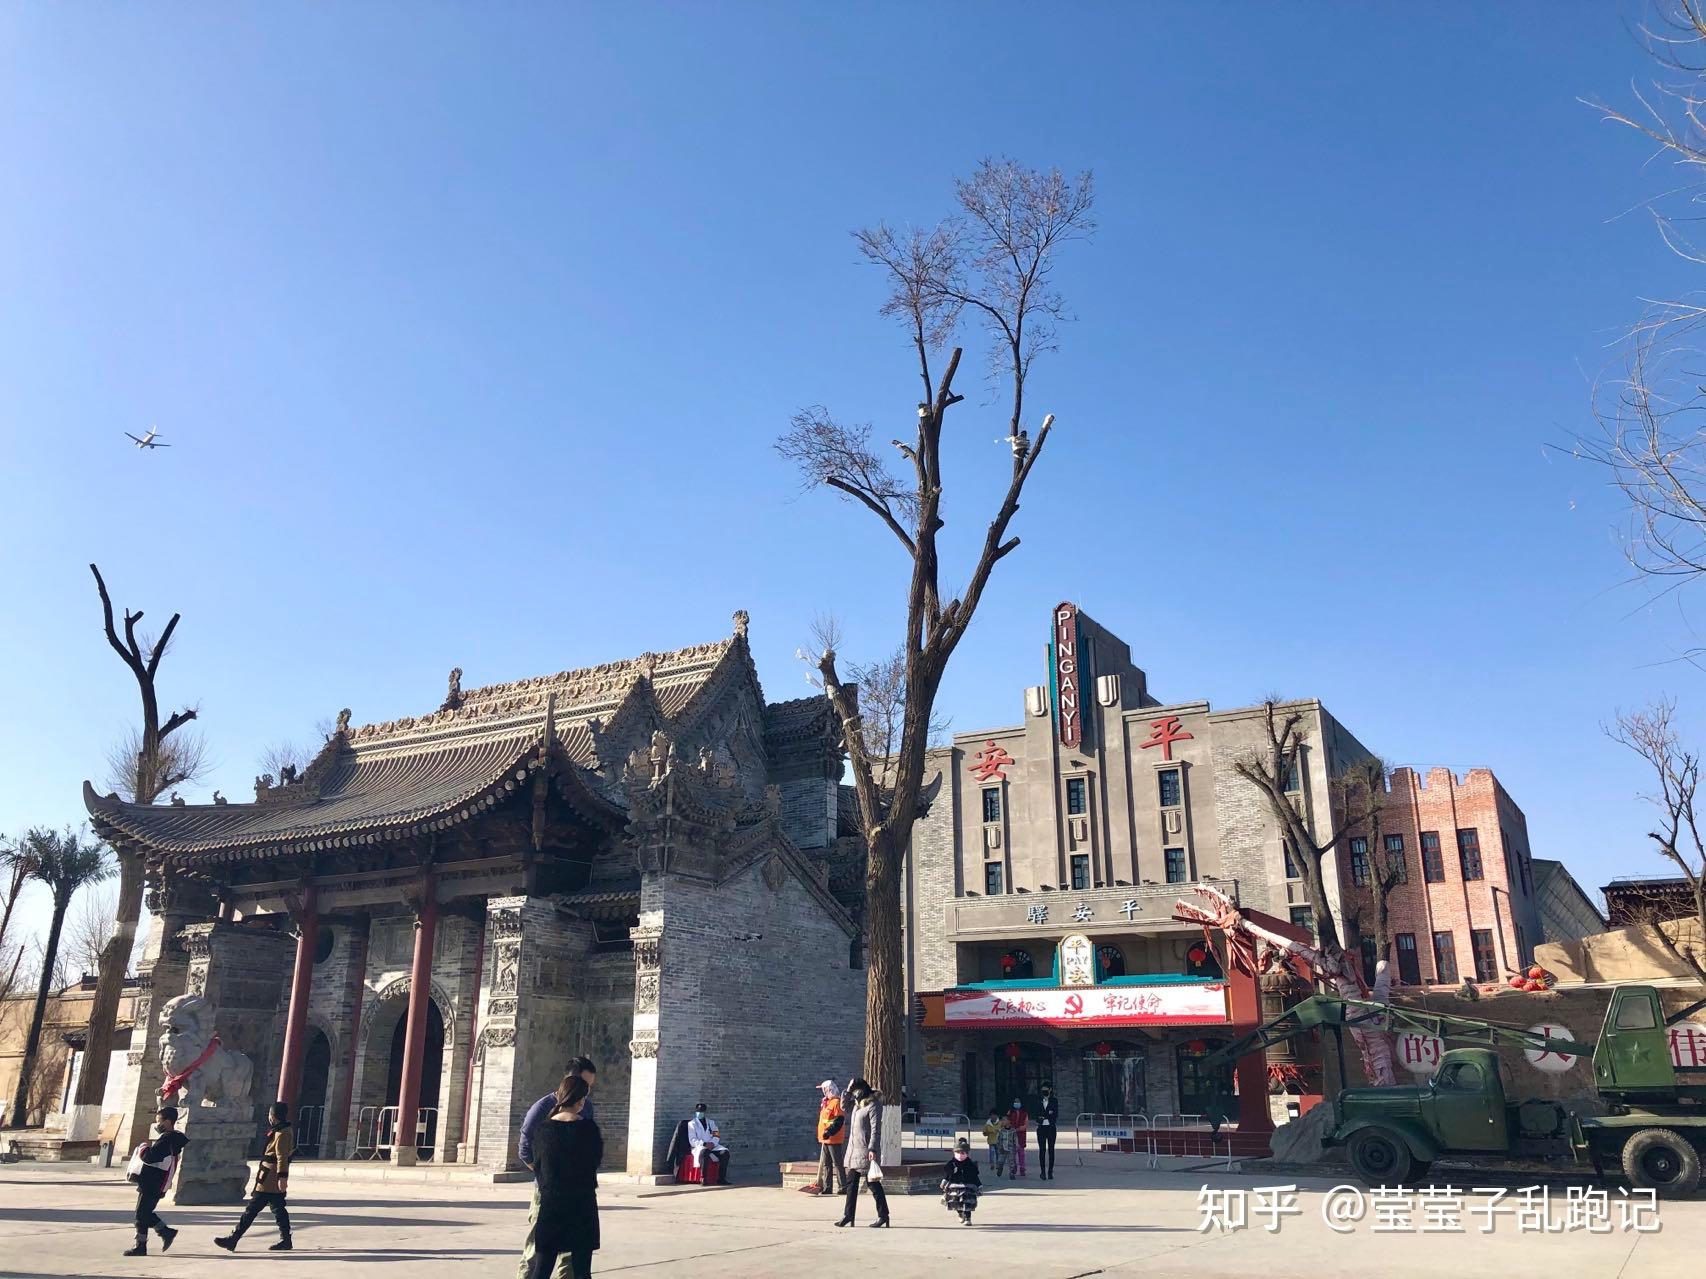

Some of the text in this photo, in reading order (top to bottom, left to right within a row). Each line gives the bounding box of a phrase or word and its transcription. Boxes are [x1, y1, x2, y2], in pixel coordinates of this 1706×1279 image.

[1057, 610, 1076, 741] PINGANYI
[991, 992, 1163, 1015] 不忘初心 牢记使命
